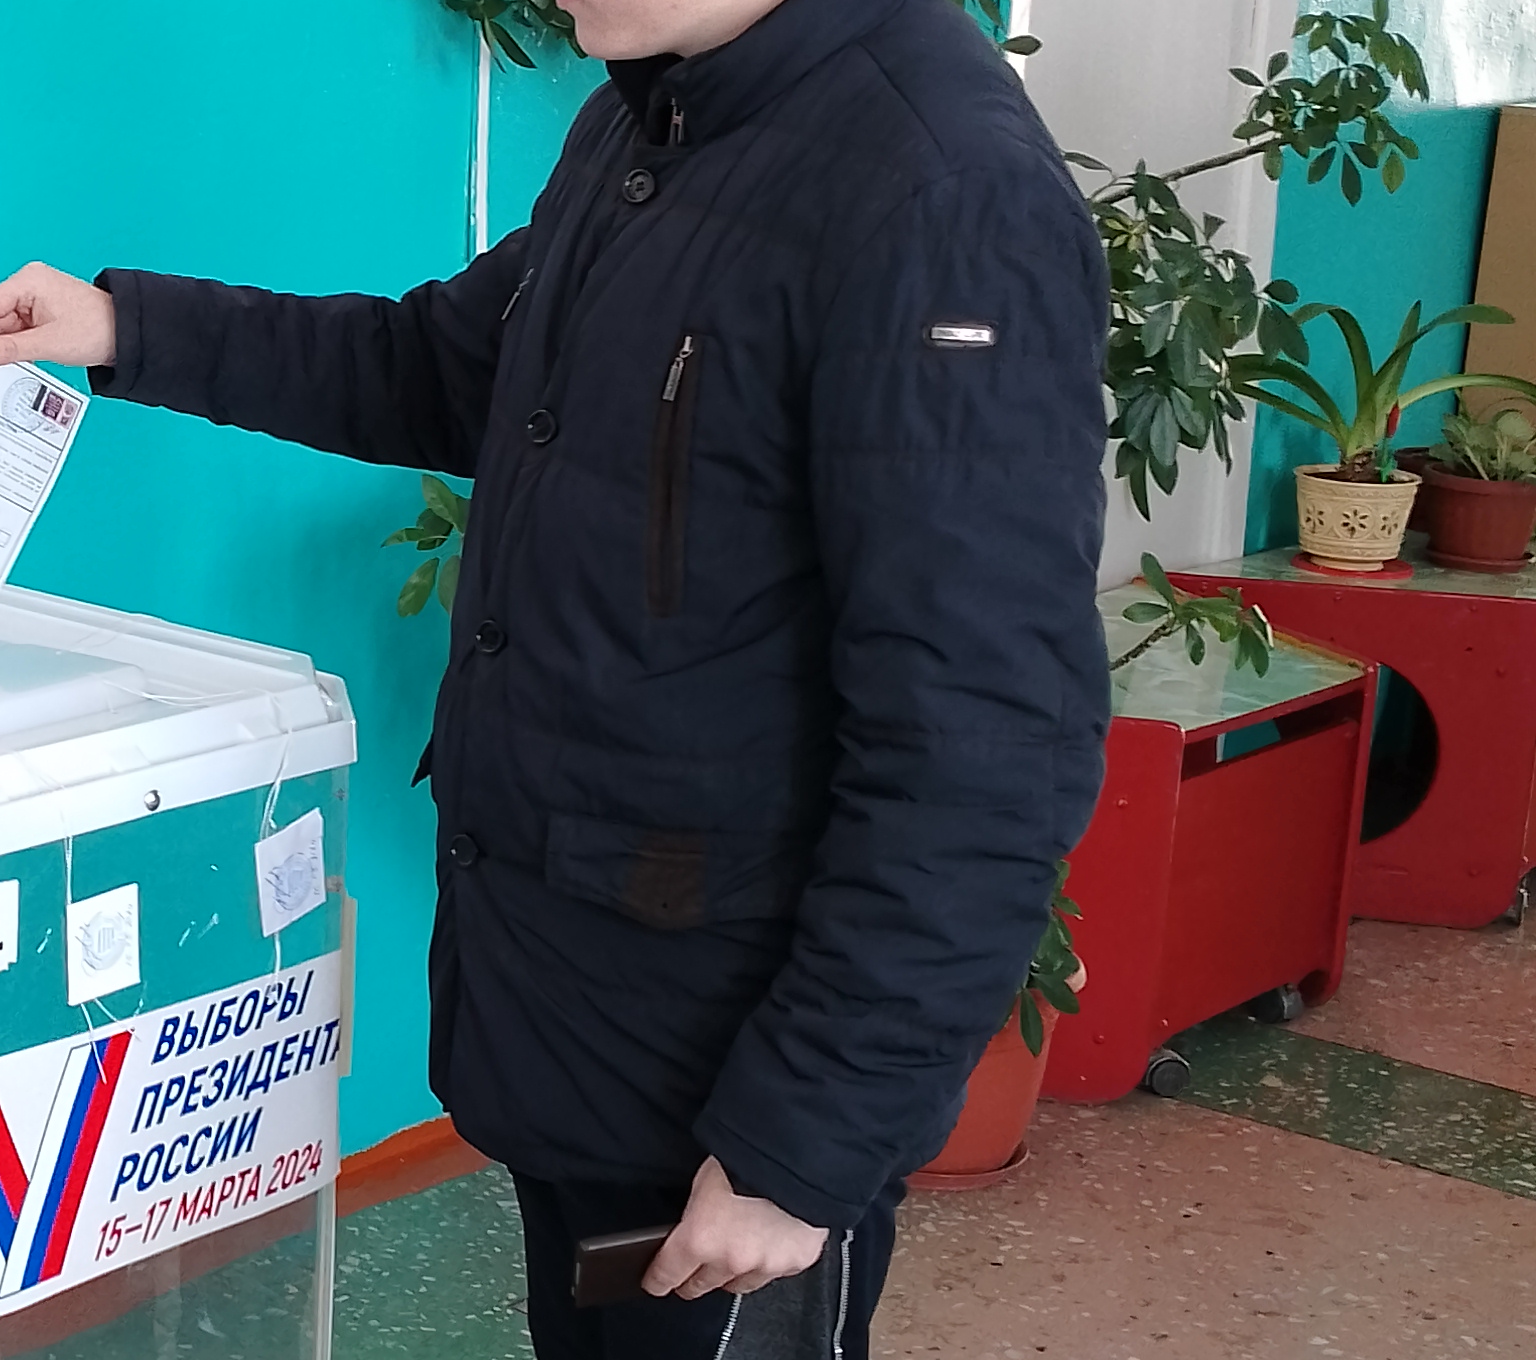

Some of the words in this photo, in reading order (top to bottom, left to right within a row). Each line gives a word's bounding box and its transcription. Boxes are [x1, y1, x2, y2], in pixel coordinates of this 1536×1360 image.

[151, 970, 315, 1065] ВЫБОРЫ
[110, 1107, 263, 1202] РОССИИ
[173, 1171, 260, 1232] МАРТА
[265, 1140, 323, 1198] 2024
